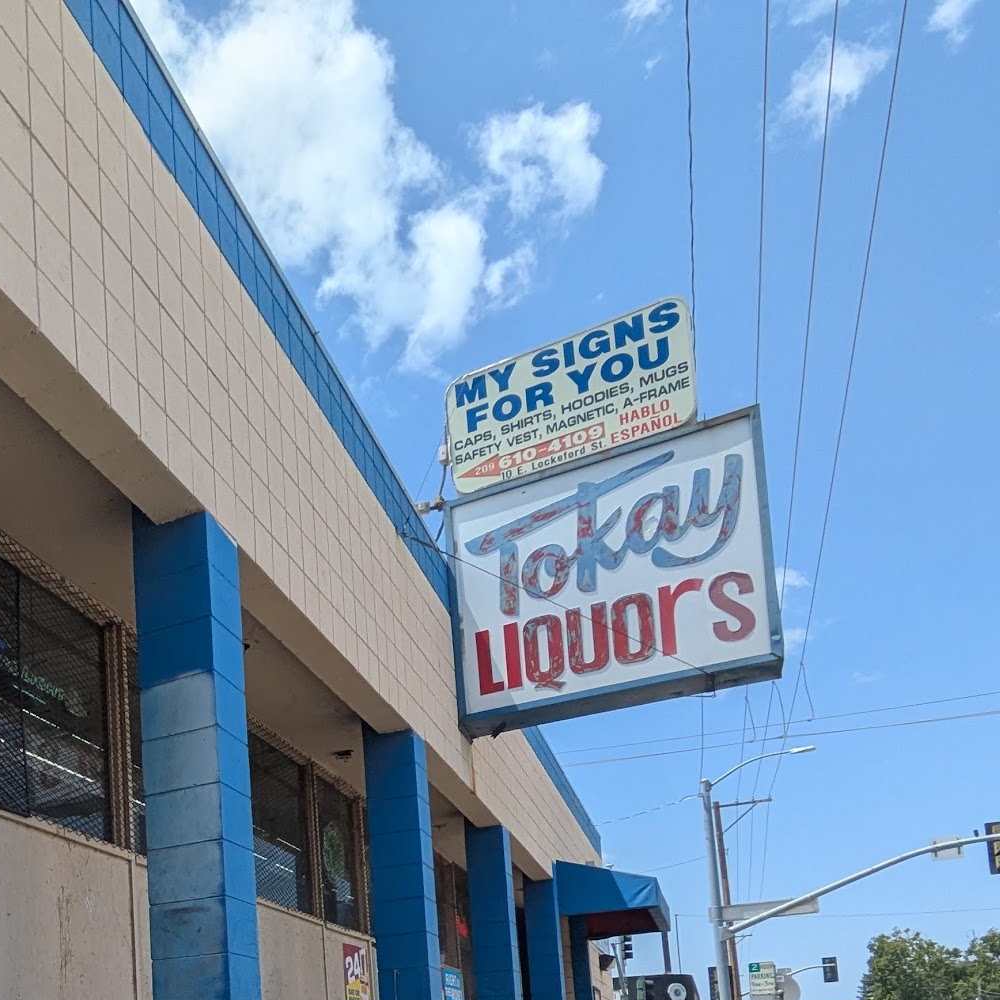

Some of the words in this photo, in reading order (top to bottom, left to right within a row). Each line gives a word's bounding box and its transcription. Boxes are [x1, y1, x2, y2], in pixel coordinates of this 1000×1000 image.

[455, 361, 518, 408] MY
[532, 301, 680, 378] SIGNS
[466, 381, 554, 433] FOR
[566, 336, 670, 395] YOU
[454, 430, 496, 451] CAPS,
[501, 409, 556, 435] SHIRTS,
[561, 382, 634, 415] HOODIES,
[639, 361, 689, 388] MUGS
[455, 440, 502, 465] SAFETY
[506, 428, 542, 447] VEST,
[546, 403, 618, 434] MAGNETIC,
[623, 376, 690, 409] A-FRAME
[475, 462, 495, 476] 209
[498, 425, 603, 469] 610-4109
[611, 412, 682, 444] ESPAÑOL
[620, 399, 670, 425] HABLO
[501, 470, 512, 480] 10
[517, 466, 527, 475] E.
[531, 446, 586, 471] Lockeford
[591, 441, 607, 451] St.
[464, 450, 743, 616] Tokay
